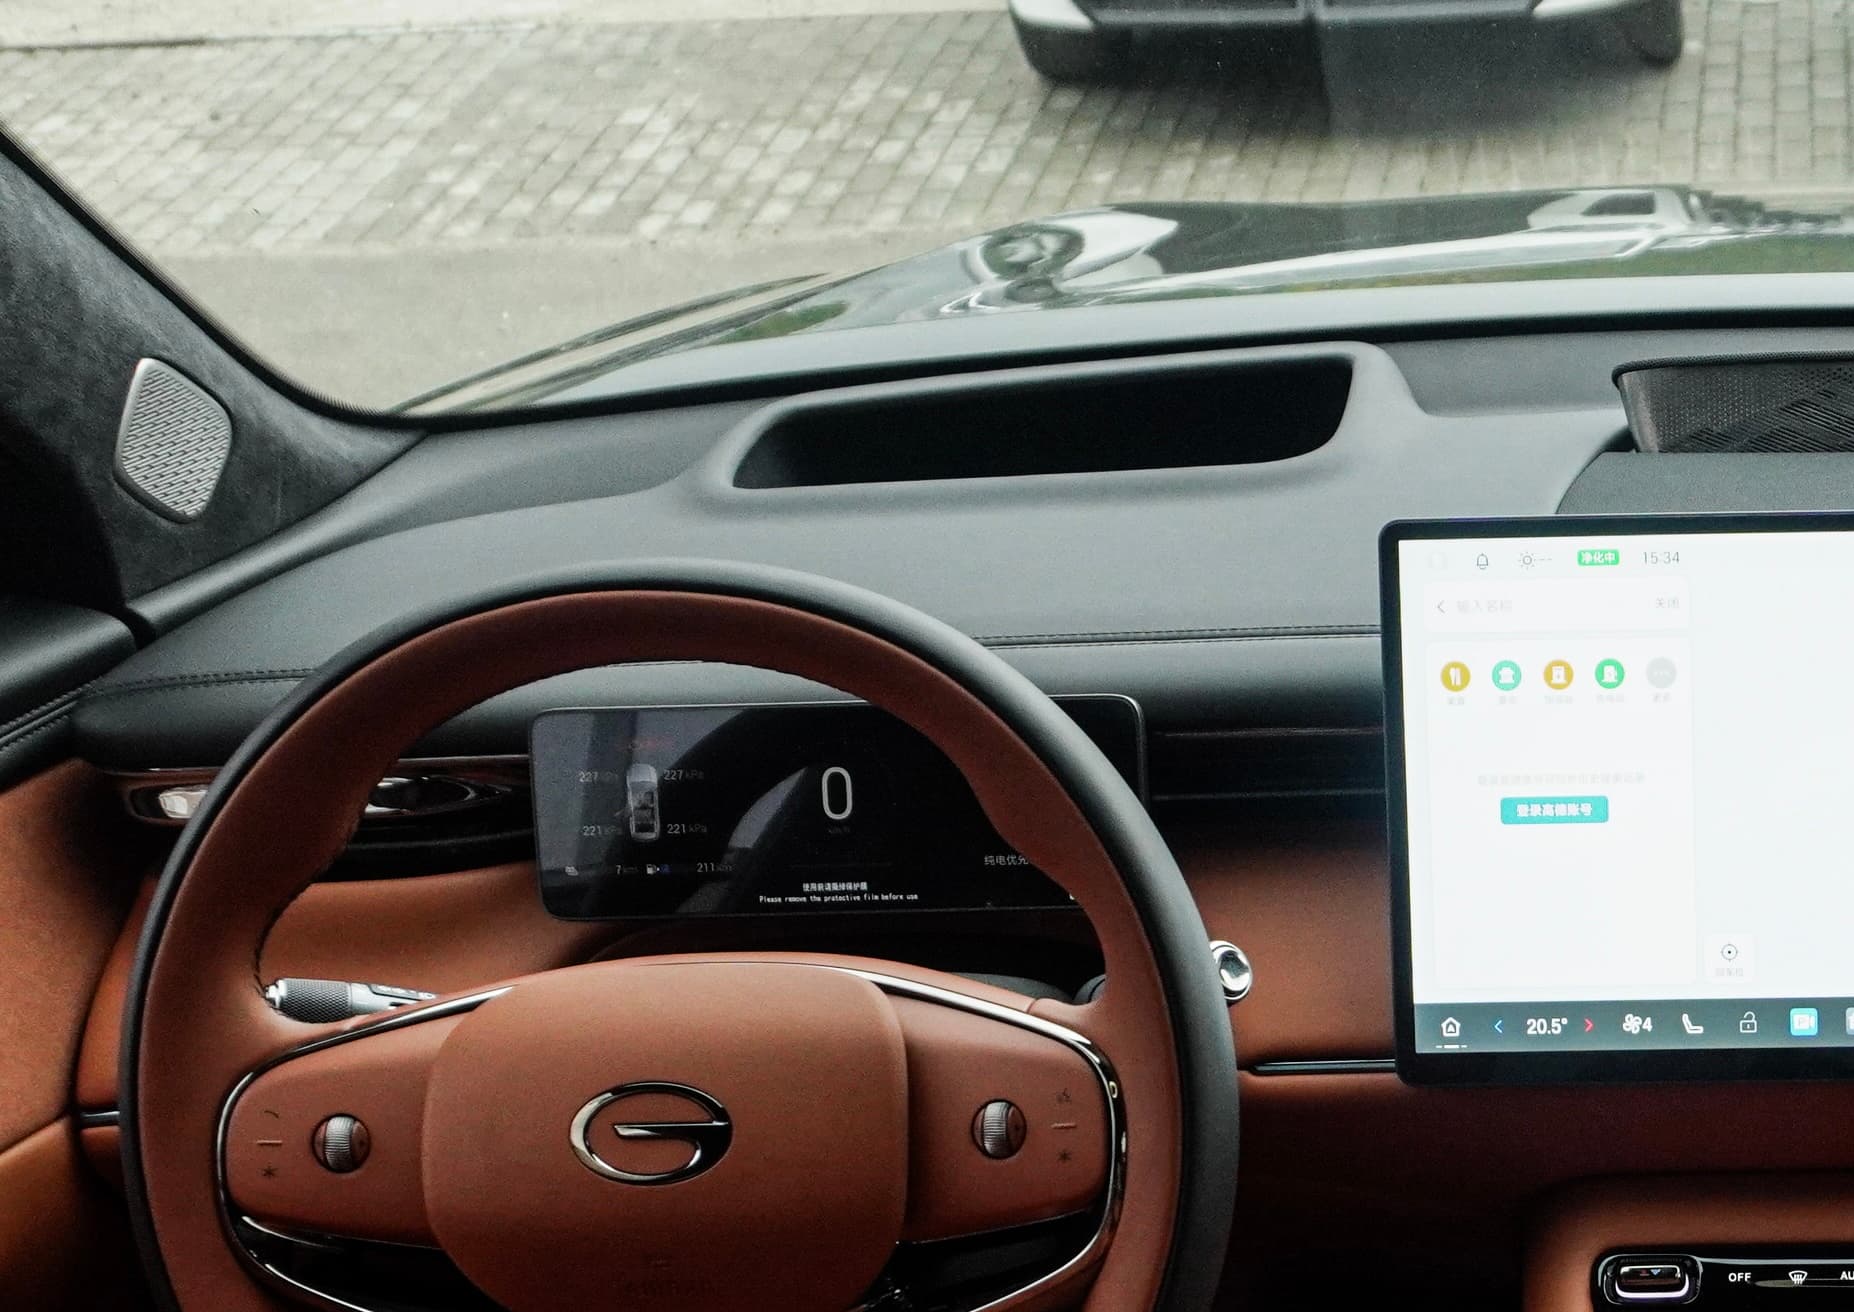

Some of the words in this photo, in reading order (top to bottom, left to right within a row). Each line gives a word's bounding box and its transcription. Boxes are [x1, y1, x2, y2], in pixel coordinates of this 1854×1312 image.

[1643, 551, 1680, 565] 15:34
[579, 771, 599, 783] 227
[663, 769, 683, 781] 227
[821, 766, 854, 820] 0
[582, 825, 602, 837] 221
[666, 823, 687, 835] 221
[695, 861, 715, 874] 211
[759, 895, 782, 904] Please
[809, 894, 822, 902] the
[1526, 1017, 1568, 1035] 20.5°
[1642, 1017, 1653, 1033] 4
[1728, 1272, 1752, 1283] OFF
